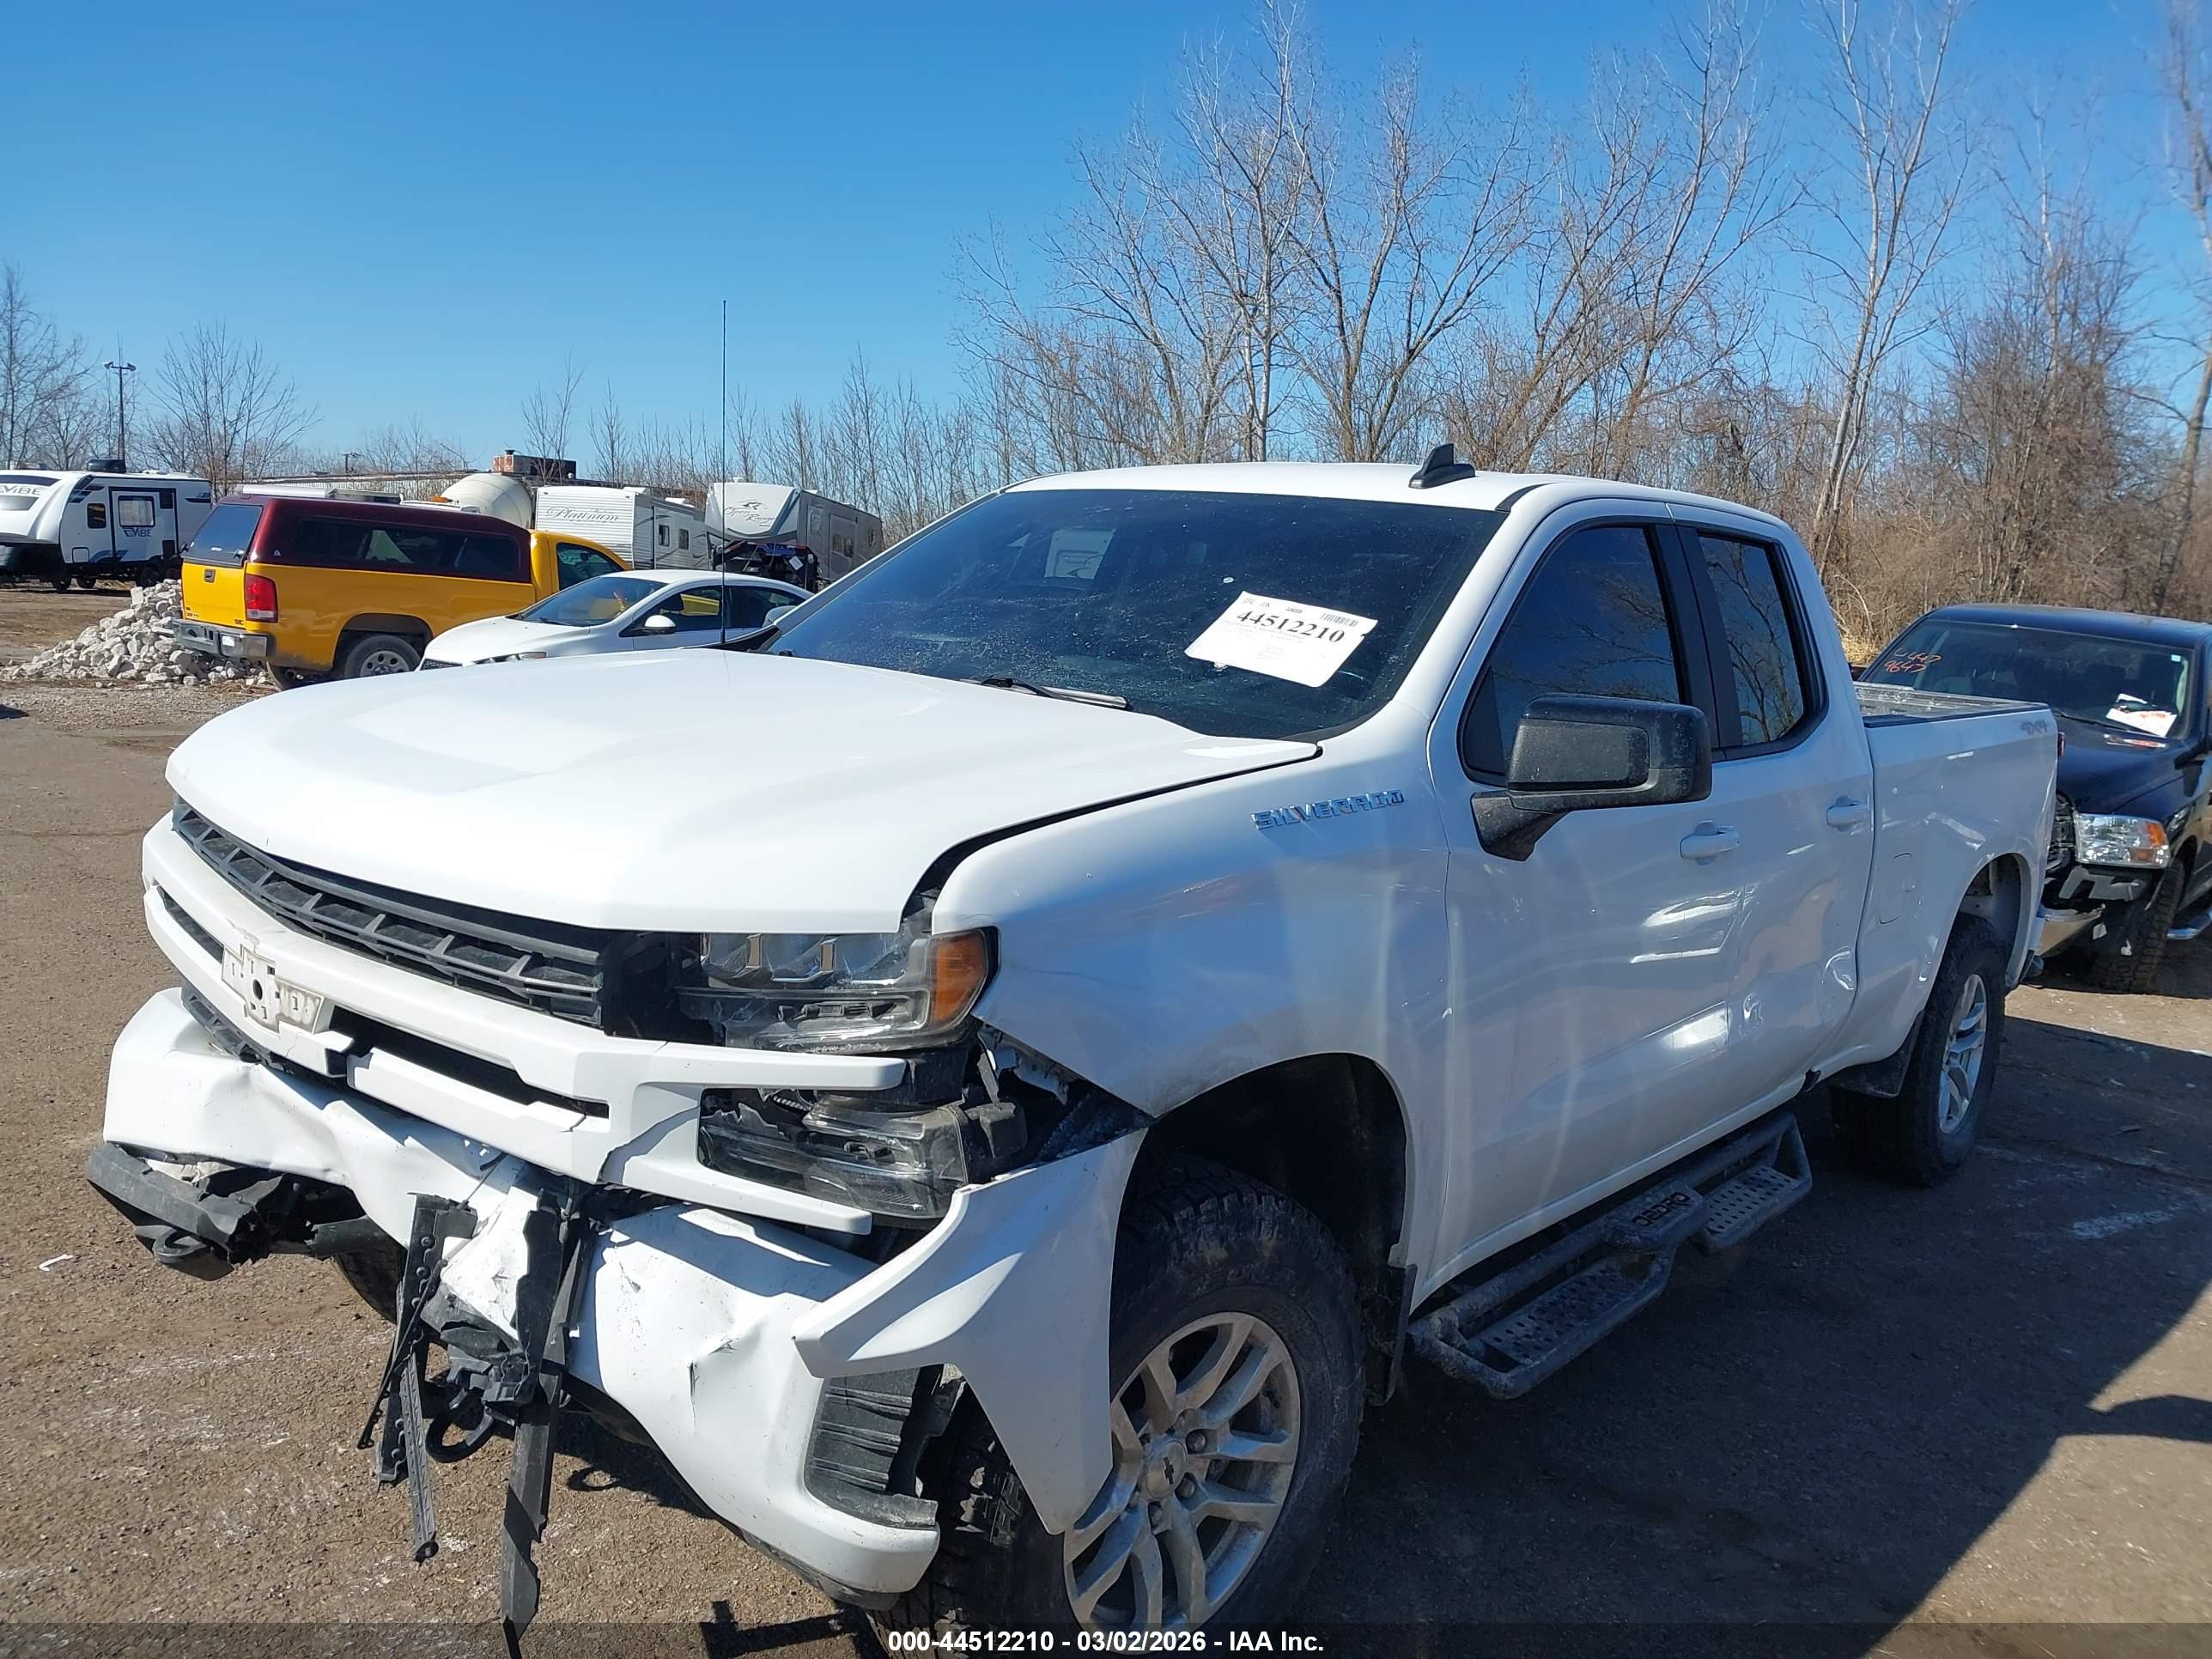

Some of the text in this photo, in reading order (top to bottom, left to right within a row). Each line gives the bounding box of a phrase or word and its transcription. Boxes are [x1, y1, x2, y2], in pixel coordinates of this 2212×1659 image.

[546, 506, 619, 522] Platinum
[1237, 611, 1346, 643] 44512210
[1250, 789, 1406, 830] SILVERADO
